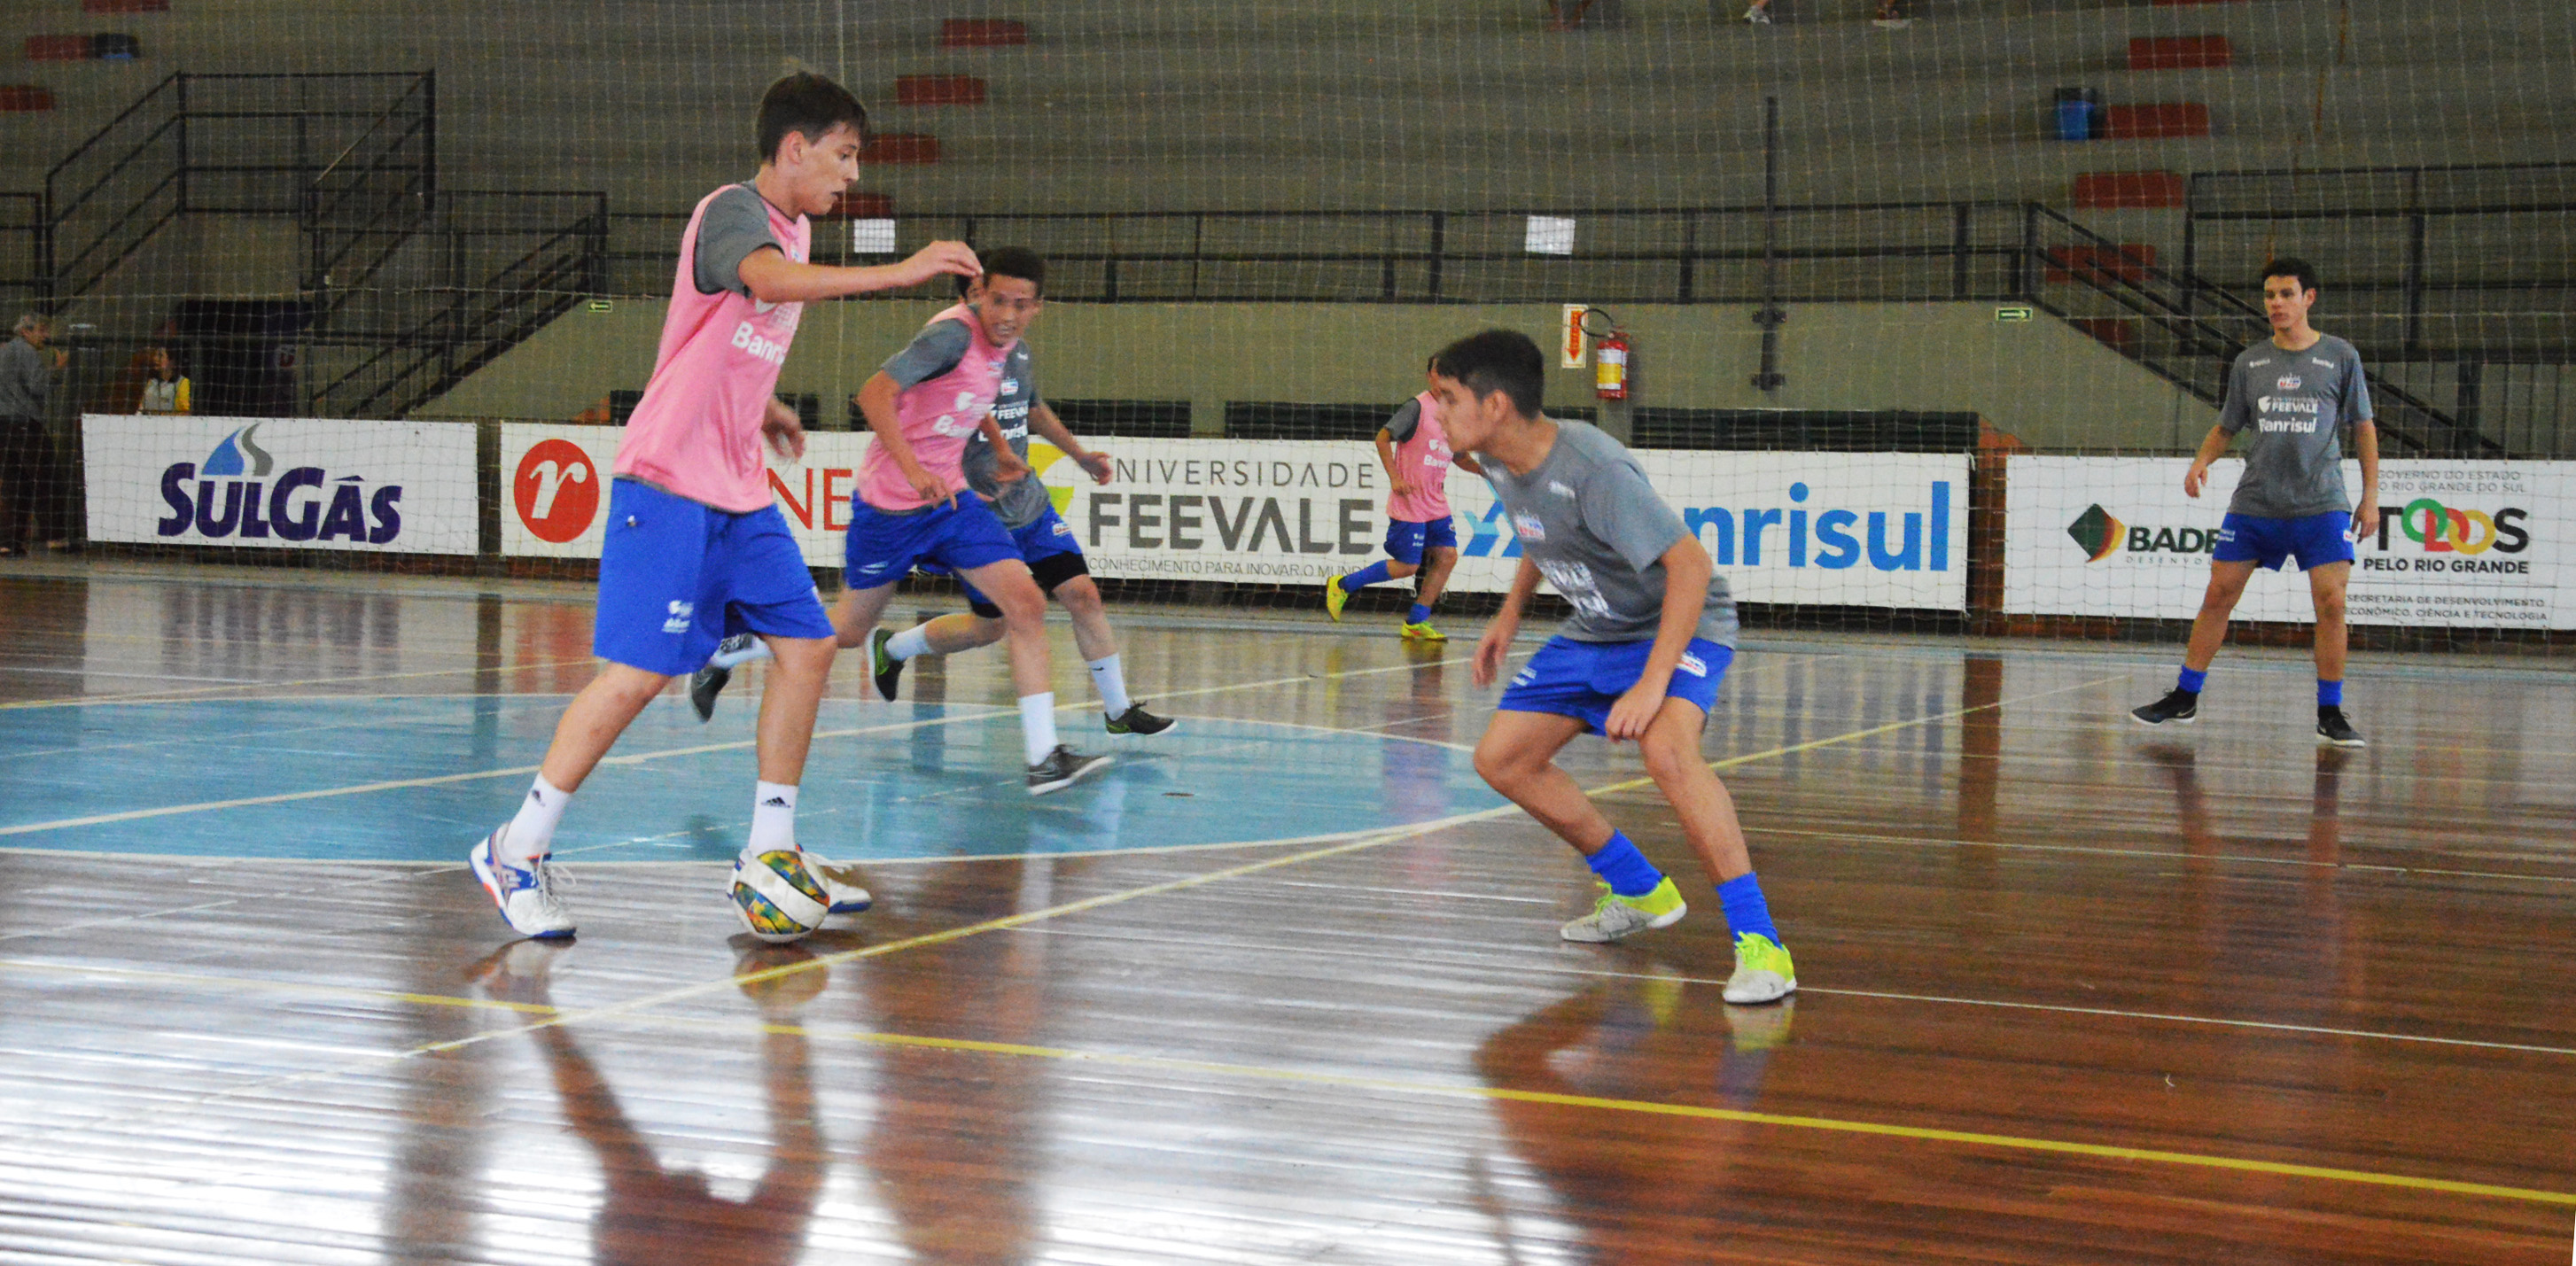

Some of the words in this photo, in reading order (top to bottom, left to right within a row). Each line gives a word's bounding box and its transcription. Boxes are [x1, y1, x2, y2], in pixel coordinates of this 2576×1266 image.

[1091, 457, 1374, 488] NIVERSIDADE
[2378, 470, 2440, 479] GOVERNO
[2445, 470, 2464, 479] DO
[2468, 470, 2521, 480] ESTADO
[2393, 482, 2414, 491] RIO
[2419, 482, 2473, 493] GRANDE
[2478, 483, 2498, 492] DO
[2502, 483, 2527, 493] SUL
[1089, 492, 1375, 555] FEEVALE
[1089, 557, 1202, 573] CONHECIMENTO
[1205, 561, 1244, 574] PARA
[1247, 563, 1300, 576] INOVAR
[1304, 563, 1314, 577] O
[1318, 565, 1366, 578] MUND
[2363, 558, 2409, 572] PELO
[2415, 559, 2446, 572] RIO
[2451, 561, 2529, 575] GRANDE
[2346, 594, 2414, 604] SECRETARIA
[2416, 595, 2432, 604] DE
[2434, 596, 2545, 608] DESENVOLVIMENTO
[2473, 610, 2547, 620] TECNOLOGIA
